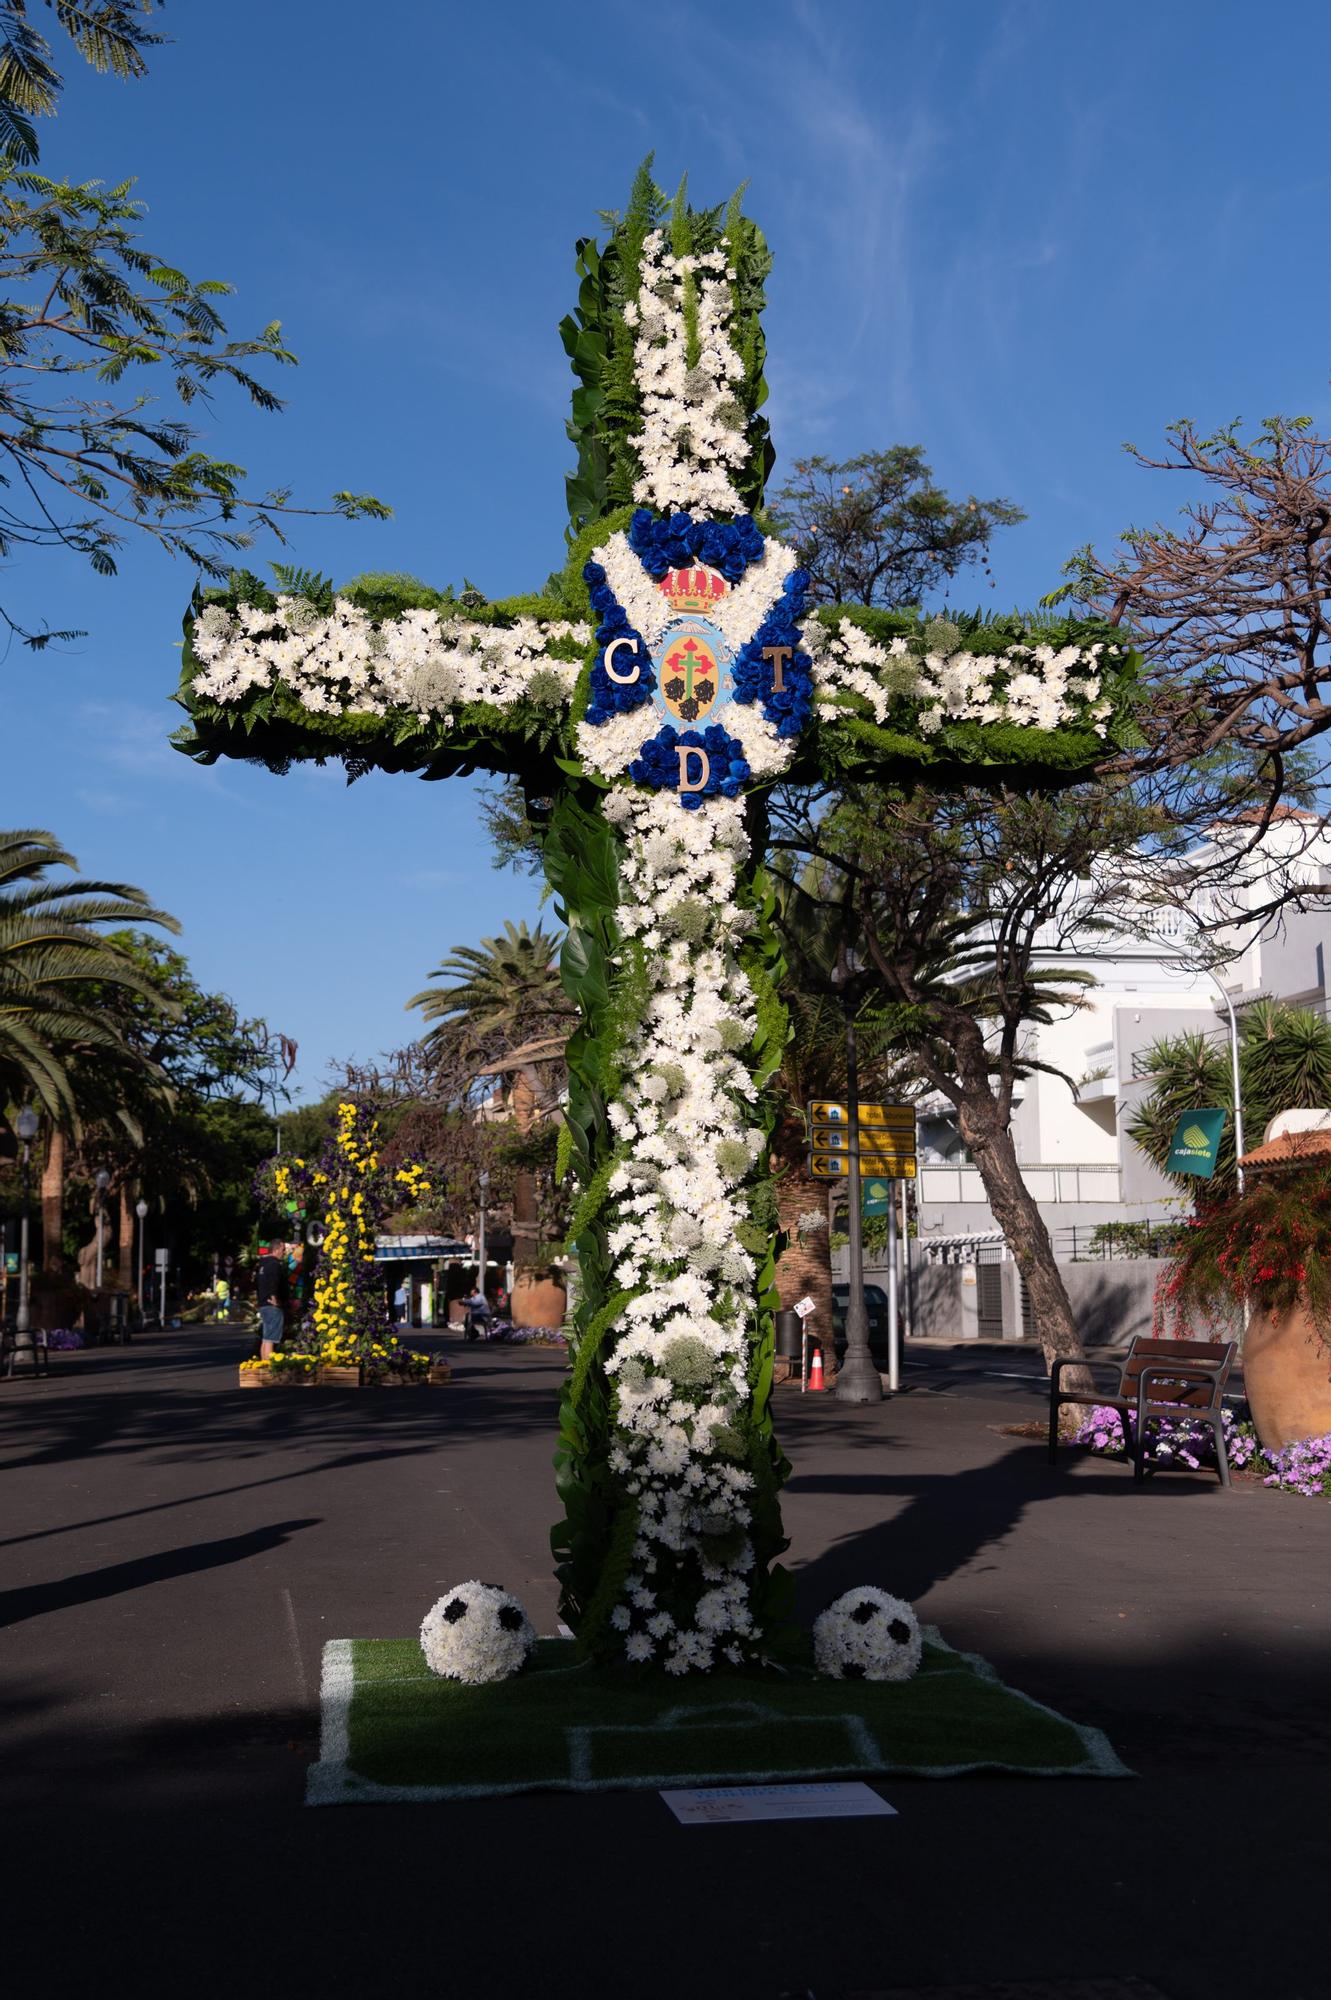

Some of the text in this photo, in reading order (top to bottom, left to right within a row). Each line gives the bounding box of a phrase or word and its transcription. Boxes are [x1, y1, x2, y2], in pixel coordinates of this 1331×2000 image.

[604, 638, 640, 684] C
[762, 646, 792, 693] T
[675, 745, 710, 792] D
[867, 1111, 881, 1119] hotel
[1174, 1147, 1211, 1158] cajasiete
